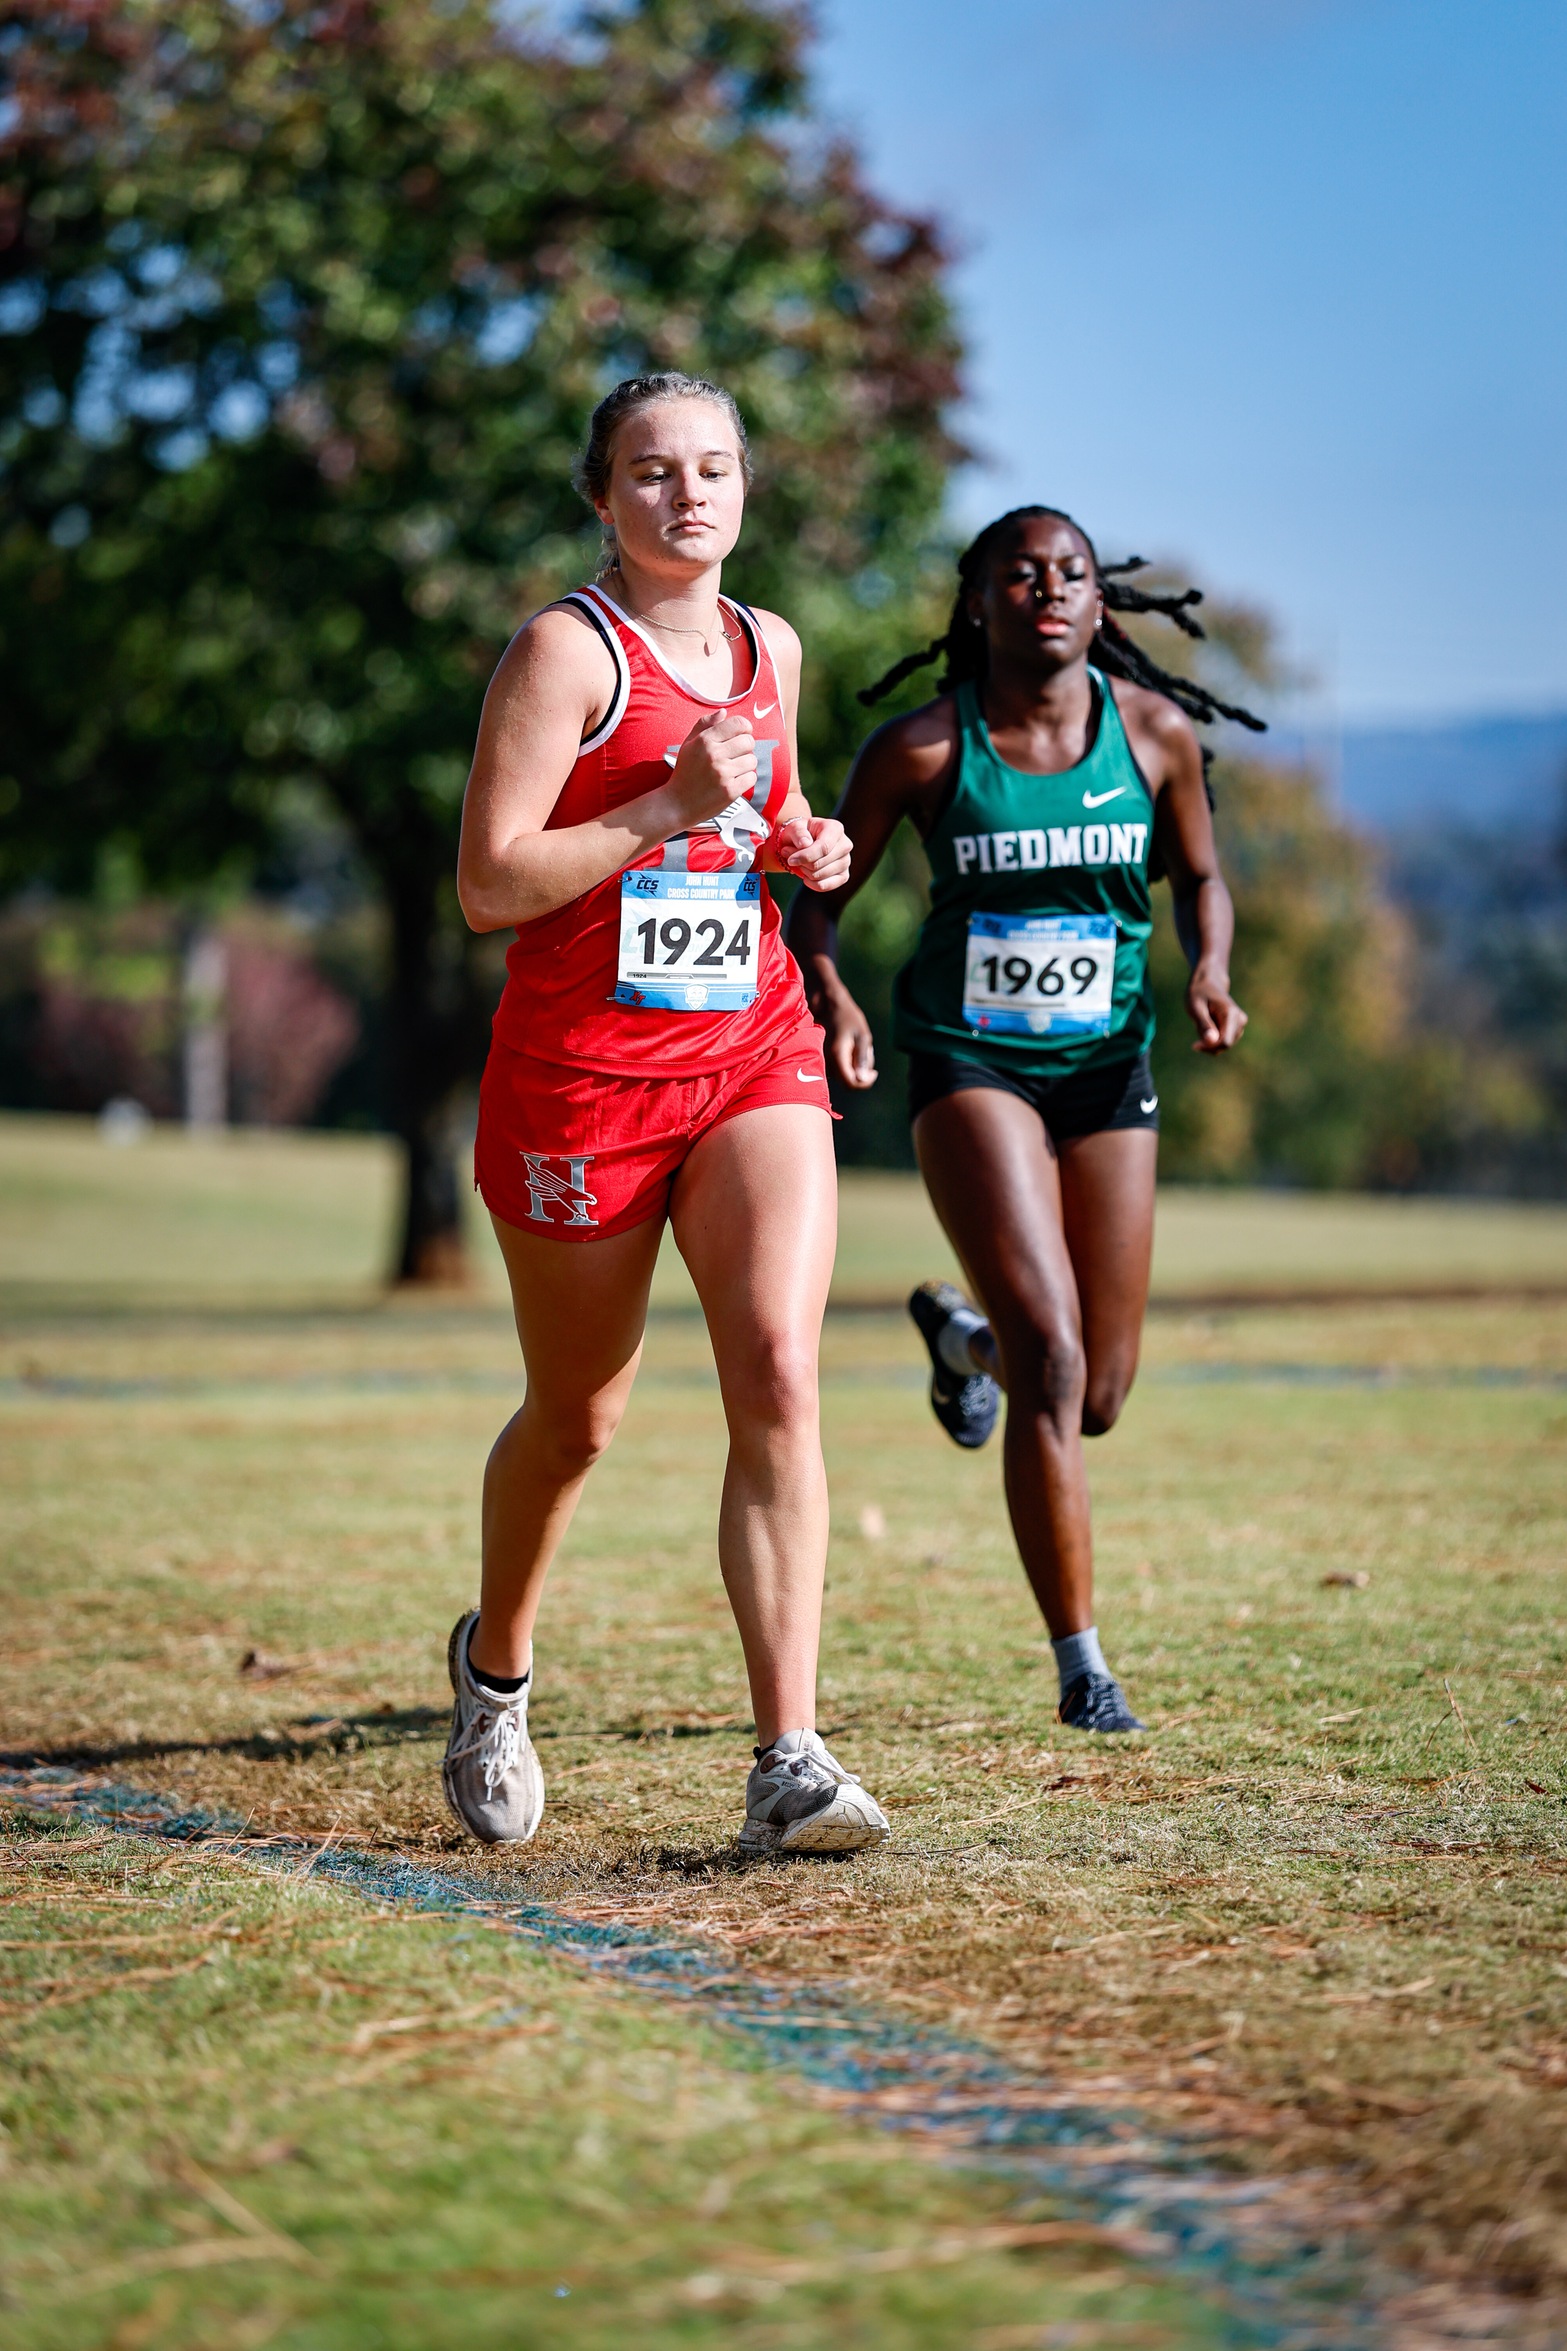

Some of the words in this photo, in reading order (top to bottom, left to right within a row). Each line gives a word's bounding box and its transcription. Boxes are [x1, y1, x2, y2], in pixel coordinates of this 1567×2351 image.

[953, 823, 1147, 874] PIEDMONT
[636, 879, 659, 890] CCS
[667, 889, 689, 899] CROSS
[690, 889, 718, 899] COUNTRY
[743, 881, 756, 892] CCS
[637, 918, 751, 966] 1924
[983, 955, 1098, 996] 1969
